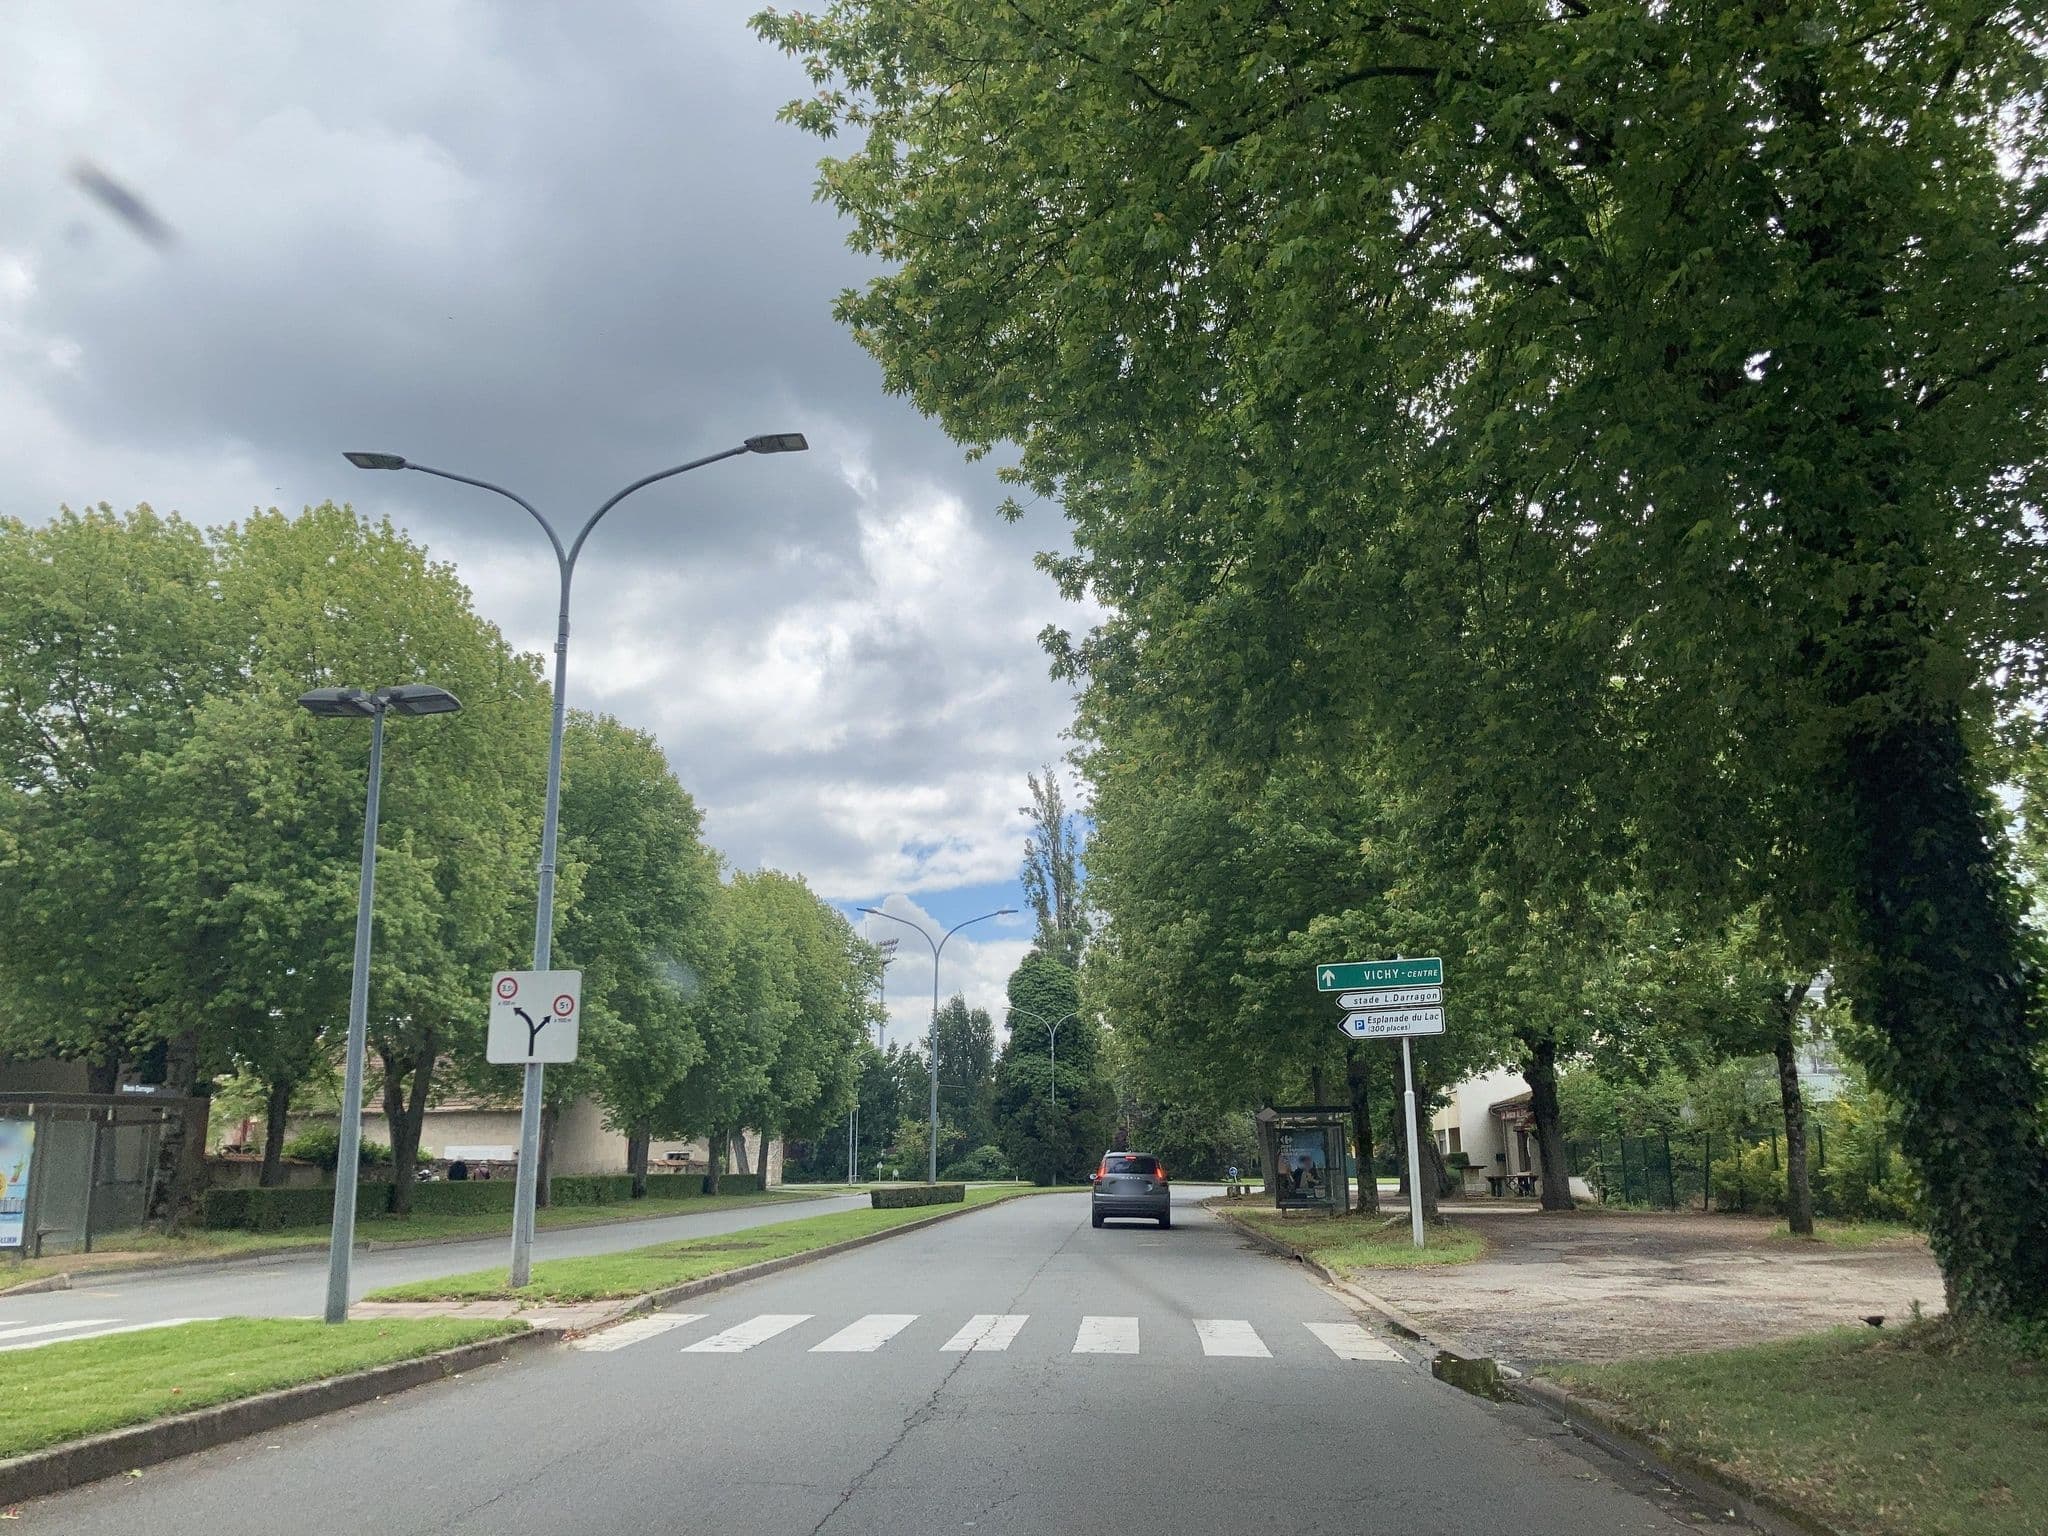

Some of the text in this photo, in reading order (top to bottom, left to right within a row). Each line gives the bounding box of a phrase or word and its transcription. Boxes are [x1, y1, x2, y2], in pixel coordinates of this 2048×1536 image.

[1364, 969, 1399, 980] VICHY
[1407, 969, 1439, 978] CENTRE
[1353, 996, 1380, 1005] stade
[1367, 1012, 1439, 1024] Esplanade du Lac
[1368, 1024, 1411, 1033] (300 places)
